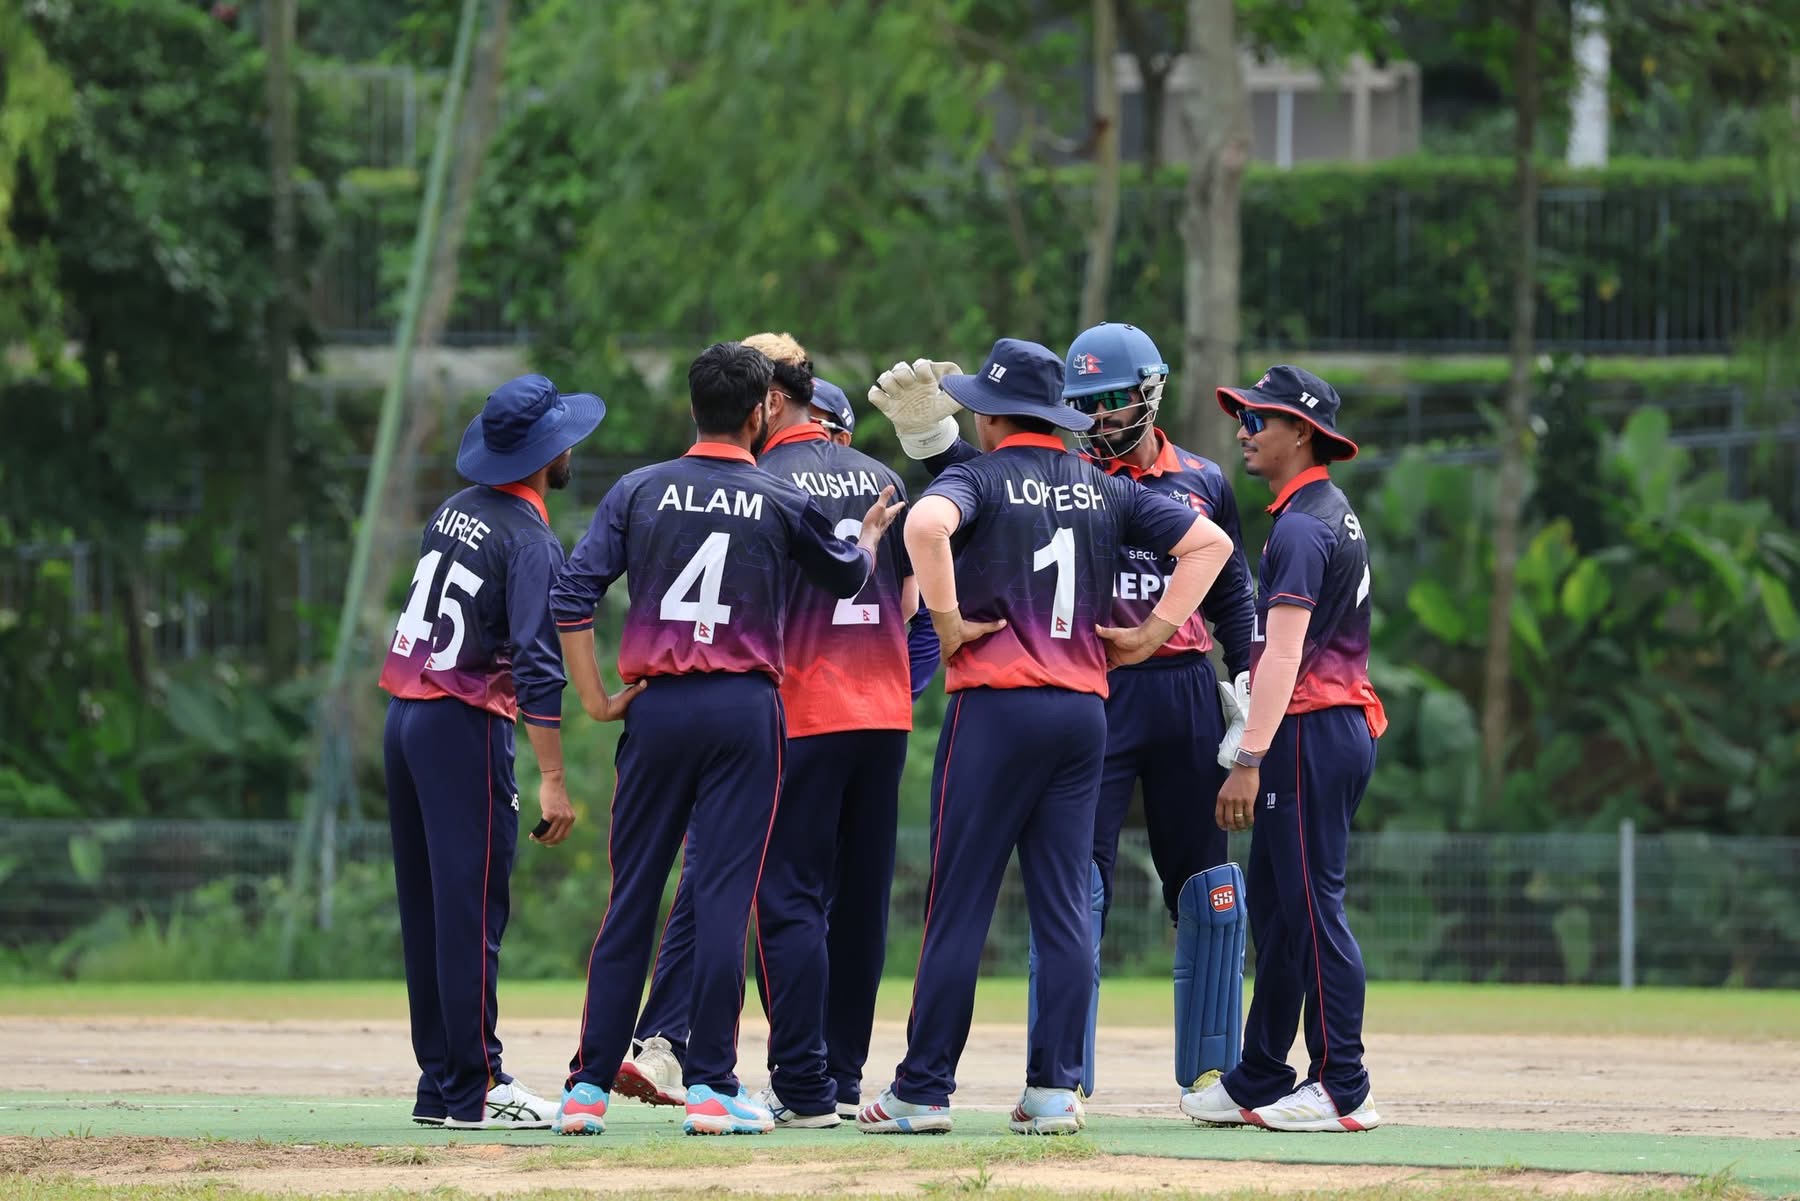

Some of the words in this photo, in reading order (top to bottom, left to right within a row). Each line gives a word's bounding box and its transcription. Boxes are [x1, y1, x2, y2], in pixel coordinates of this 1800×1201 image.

[657, 484, 763, 520] ALAM
[1006, 478, 1106, 512] LOKESH
[432, 507, 491, 551] AIREE
[659, 532, 731, 644] 4
[1033, 527, 1075, 639] 1
[392, 549, 484, 672] 45
[1213, 890, 1233, 906] SS
